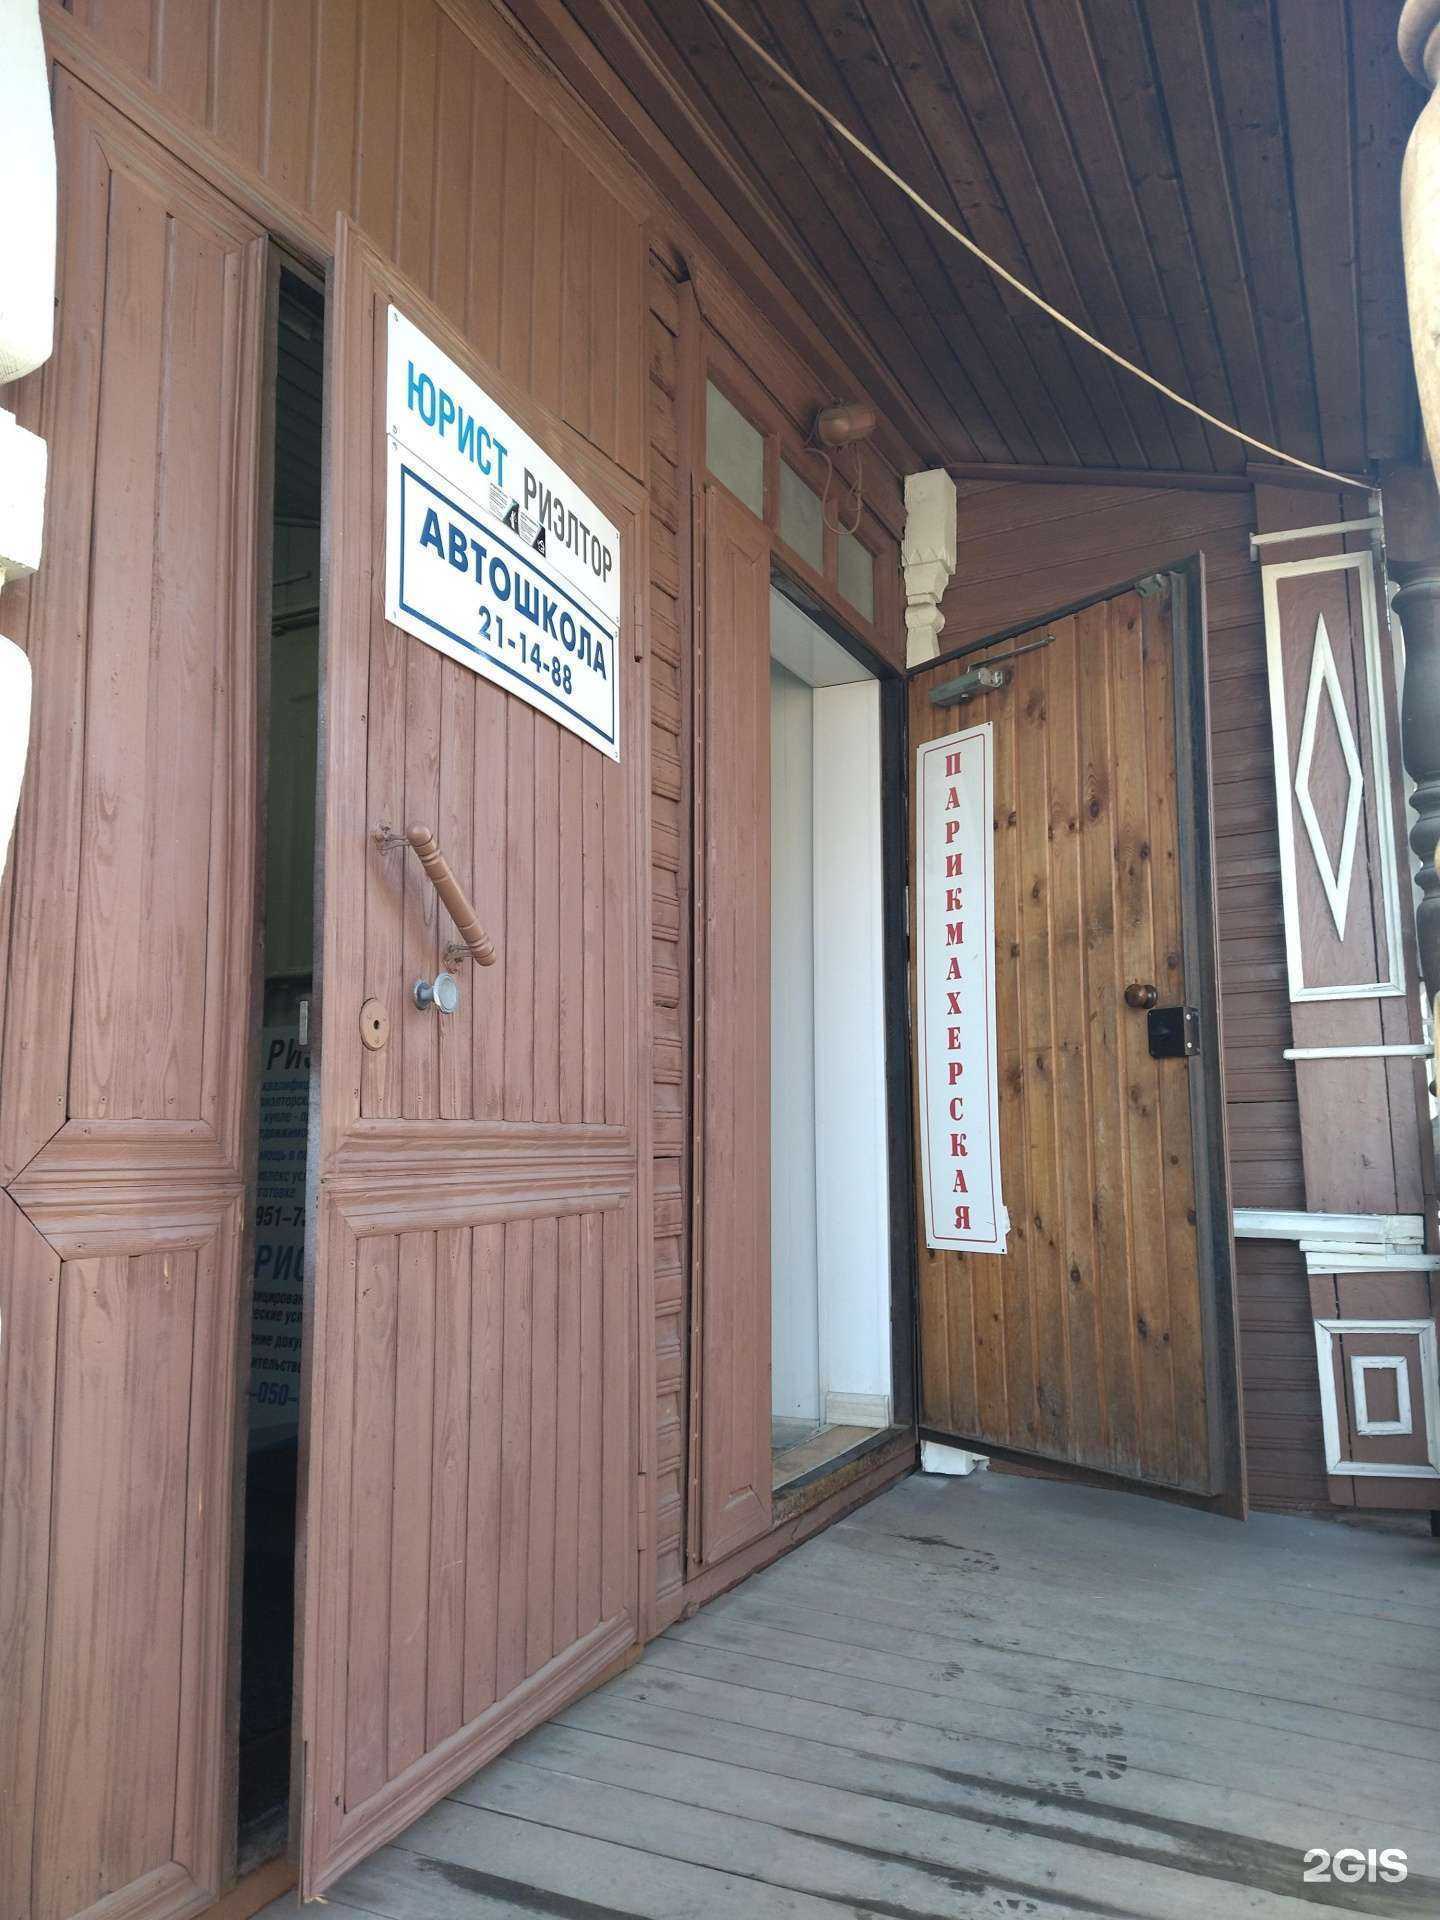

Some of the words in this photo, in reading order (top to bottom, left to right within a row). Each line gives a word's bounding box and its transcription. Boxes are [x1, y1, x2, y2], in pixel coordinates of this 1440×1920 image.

[407, 360, 507, 488] ЮРИСТ
[524, 466, 612, 584] РИЭЛТОР
[420, 507, 607, 681] АВТОШКОЛА
[478, 605, 572, 695] 21-14-88
[945, 751, 971, 1230] ПАРИКМАХЕРСКАЯ
